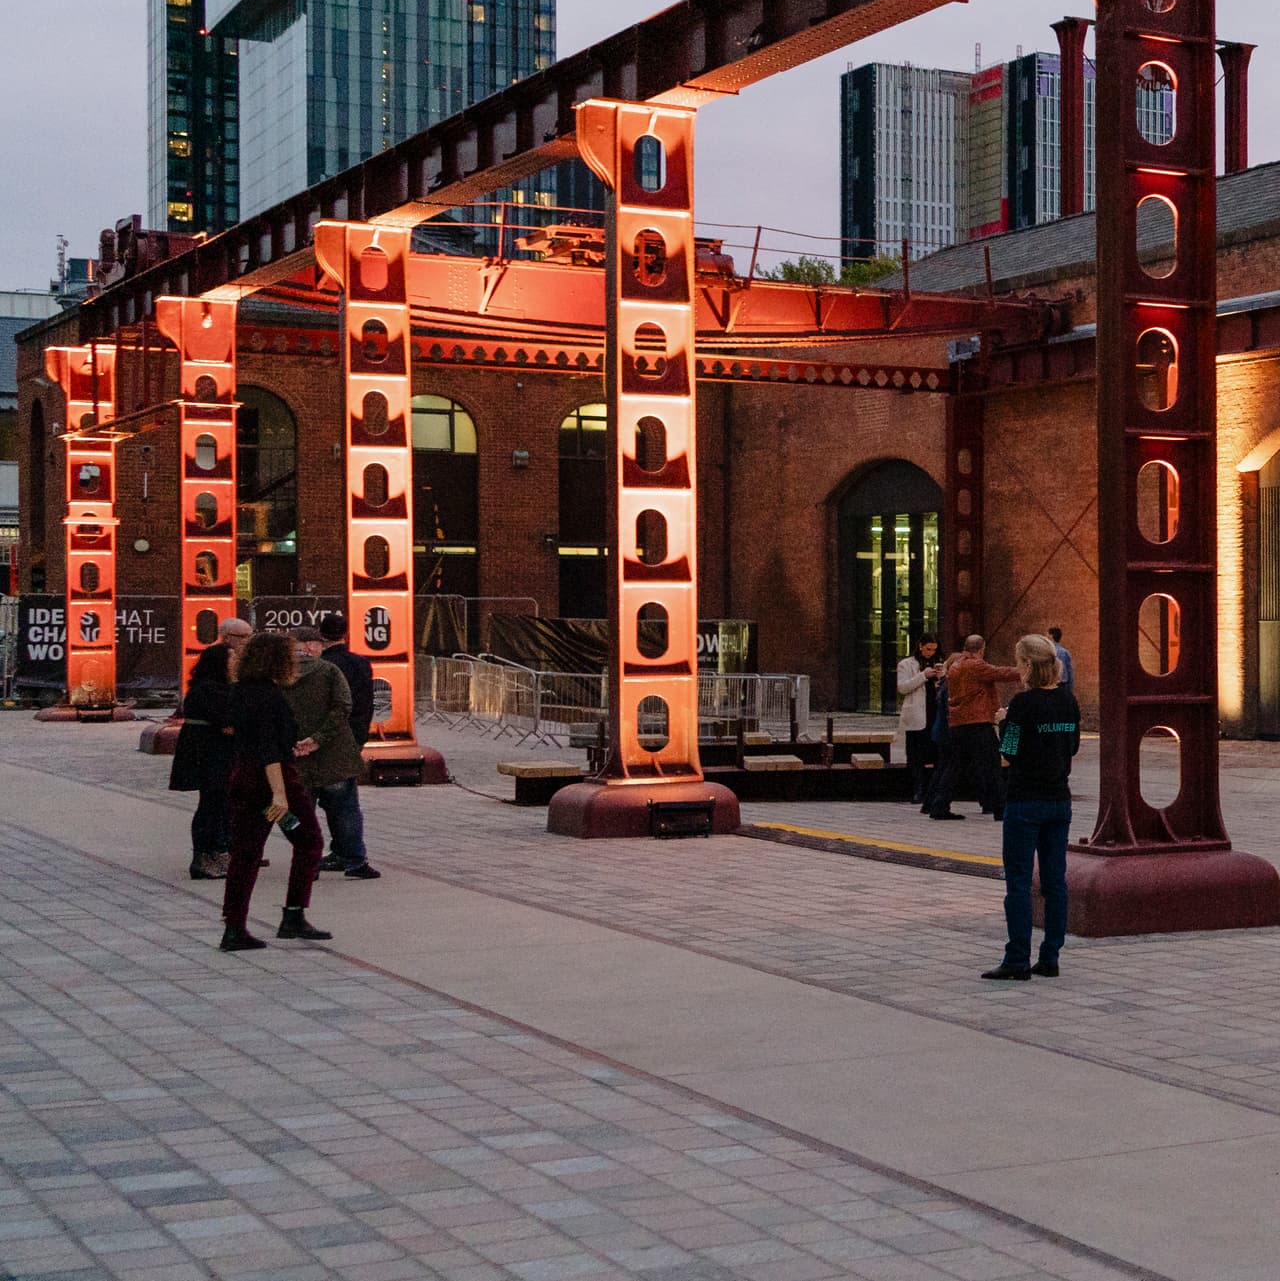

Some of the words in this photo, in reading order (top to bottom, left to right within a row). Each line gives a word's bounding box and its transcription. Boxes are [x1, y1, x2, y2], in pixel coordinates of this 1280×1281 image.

[28, 608, 93, 625] IDES
[115, 609, 154, 626] HAT
[265, 610, 303, 626] 200
[127, 627, 166, 644] THE
